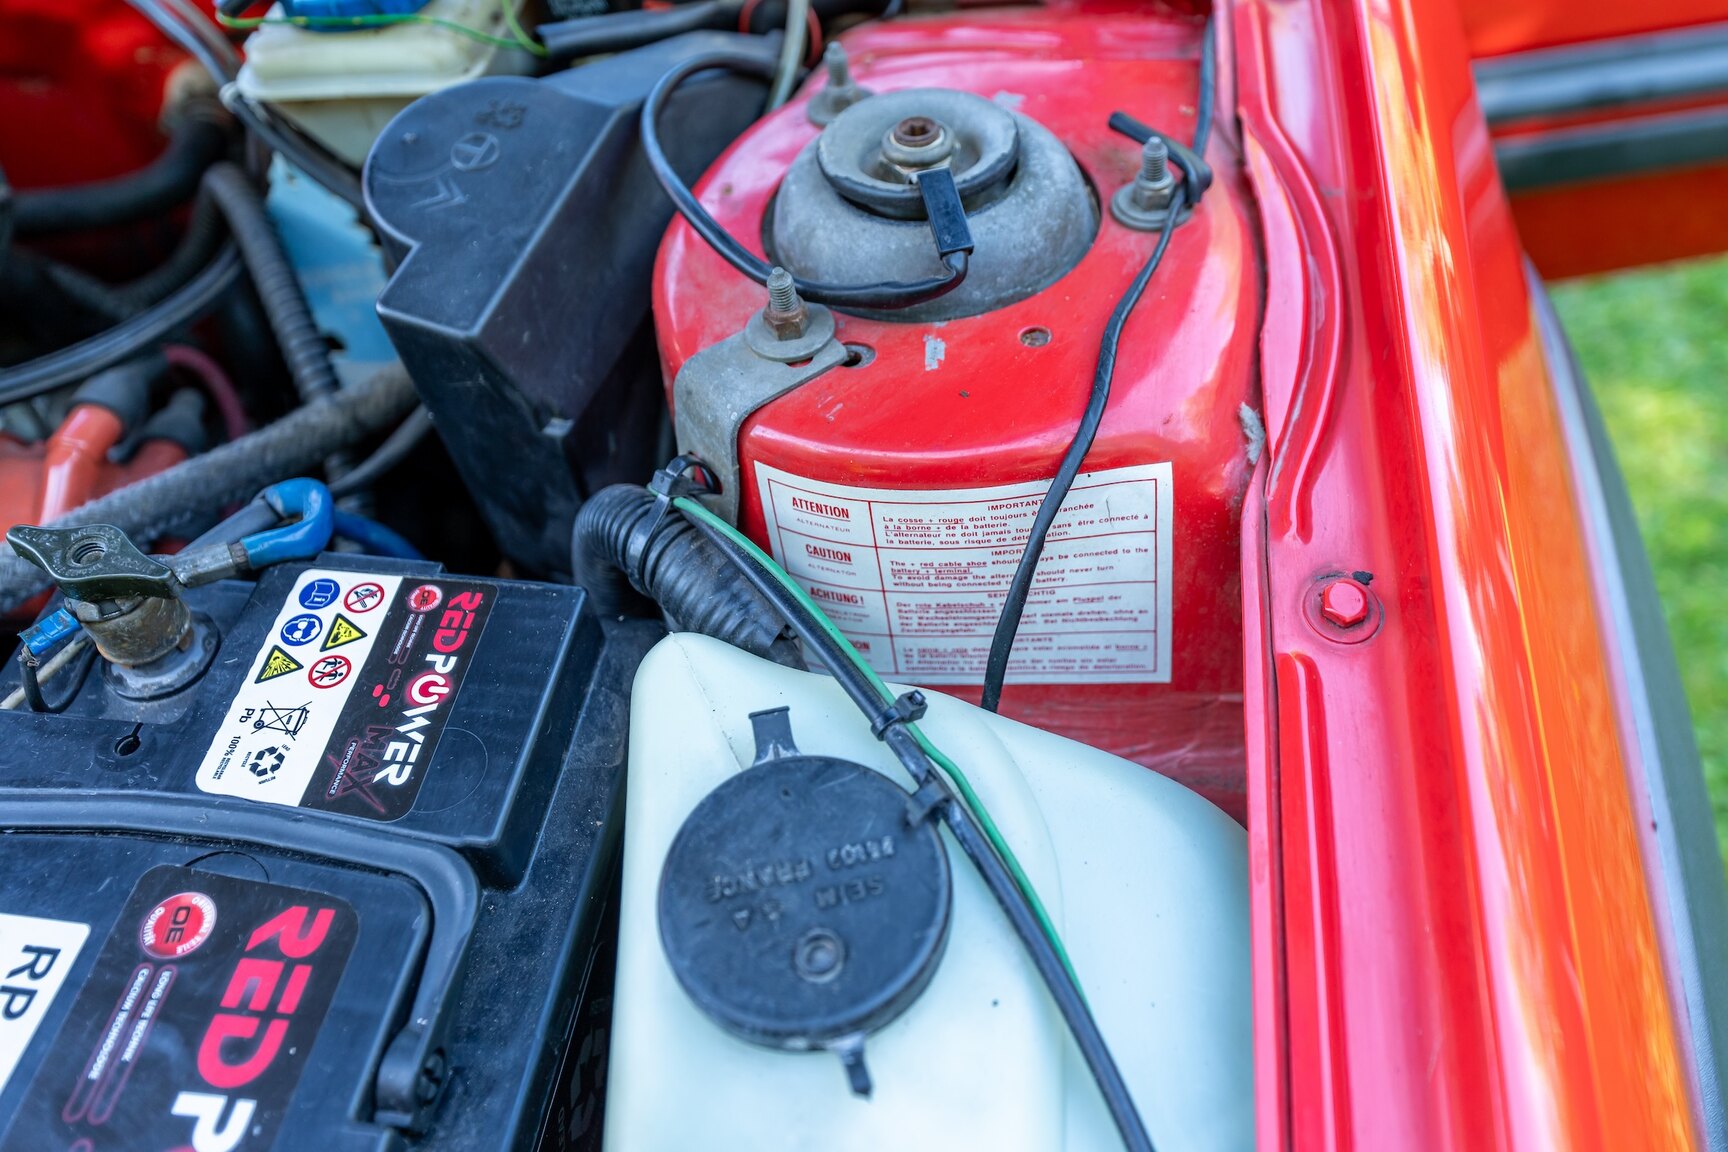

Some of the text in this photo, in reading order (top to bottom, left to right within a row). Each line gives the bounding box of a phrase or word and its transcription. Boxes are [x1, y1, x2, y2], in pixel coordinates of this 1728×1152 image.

[791, 496, 850, 519] ATTENTION
[990, 513, 1028, 521] toujours
[1059, 503, 1094, 513] ranchée
[796, 517, 851, 533] ALTERNATEUR
[973, 522, 1011, 530] batterie.
[1098, 514, 1139, 524] connecté
[805, 543, 852, 562] CAUTION
[1073, 549, 1118, 559] connected
[1036, 569, 1065, 577] should
[956, 580, 1002, 588] connected
[810, 587, 858, 604] ACHTUNG
[372, 591, 483, 786] RED POWER
[239, 707, 256, 723] Pb
[224, 735, 241, 757] 100%
[328, 741, 358, 795] PERFORMANCE
[164, 906, 191, 944] OE
[121, 968, 150, 1012] CALCIUM
[151, 970, 173, 1000] LONG
[197, 905, 336, 1089] RED
